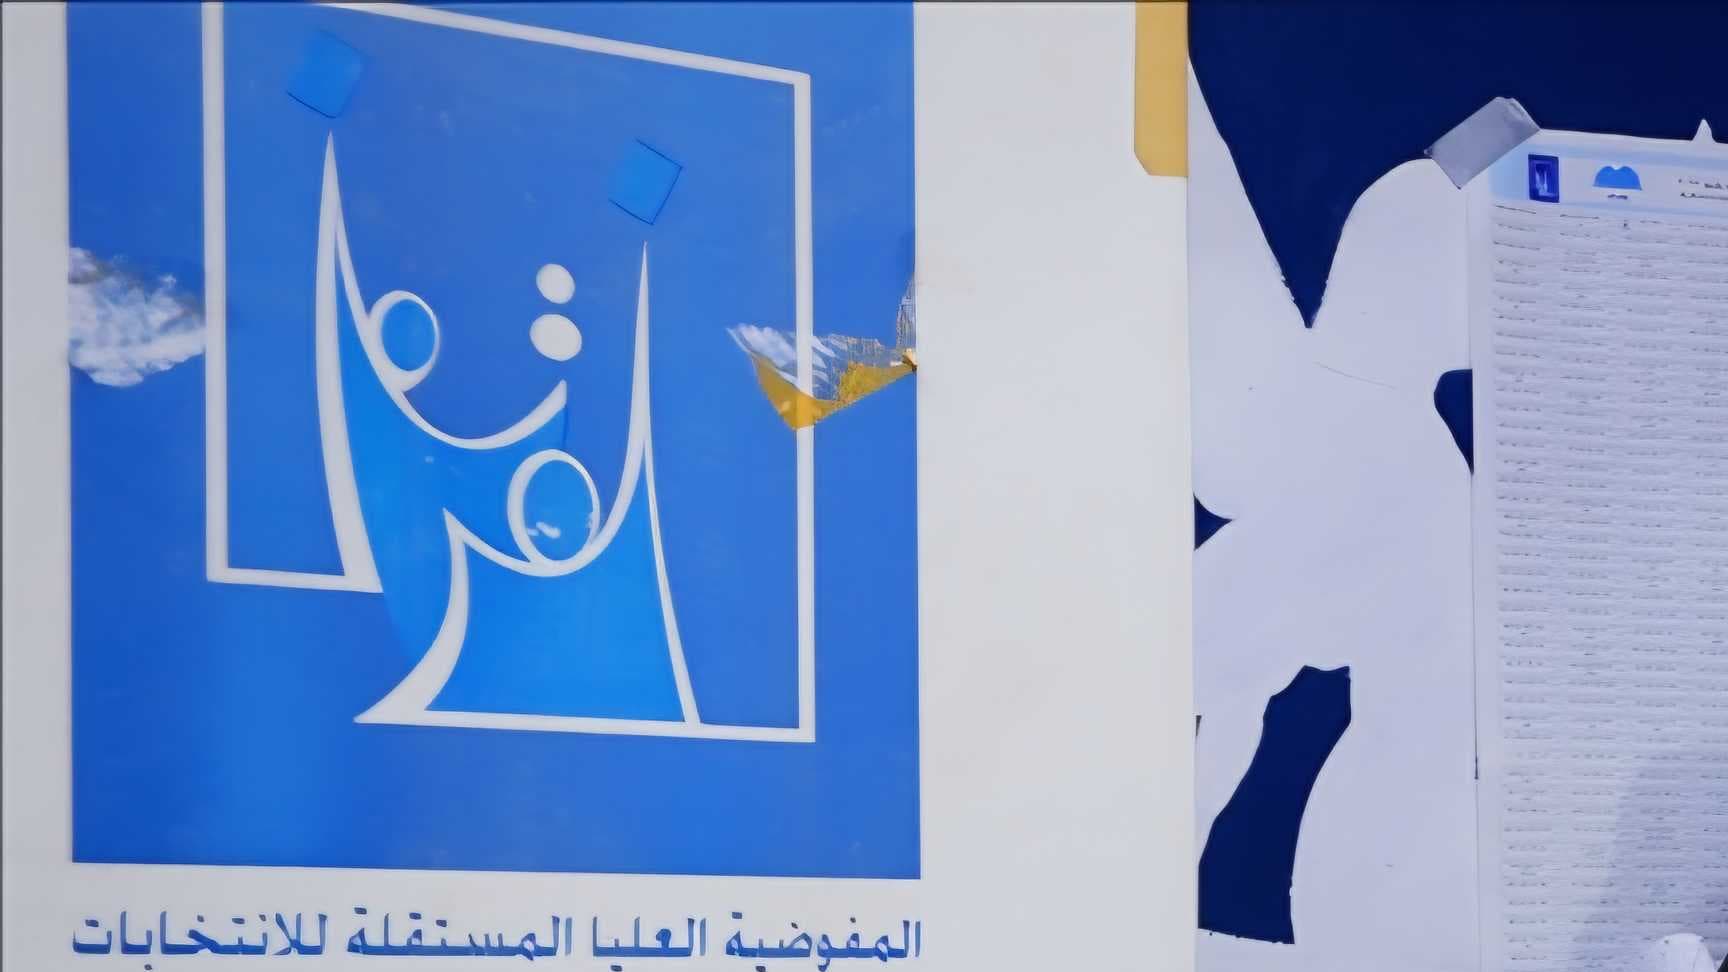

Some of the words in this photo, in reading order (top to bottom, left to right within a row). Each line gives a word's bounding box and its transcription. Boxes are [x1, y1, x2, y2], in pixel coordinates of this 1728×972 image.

[72, 910, 328, 971] للانتخابات
[347, 906, 573, 961] المستقلة
[592, 915, 707, 972] العليا
[726, 911, 921, 972] المفوضية
